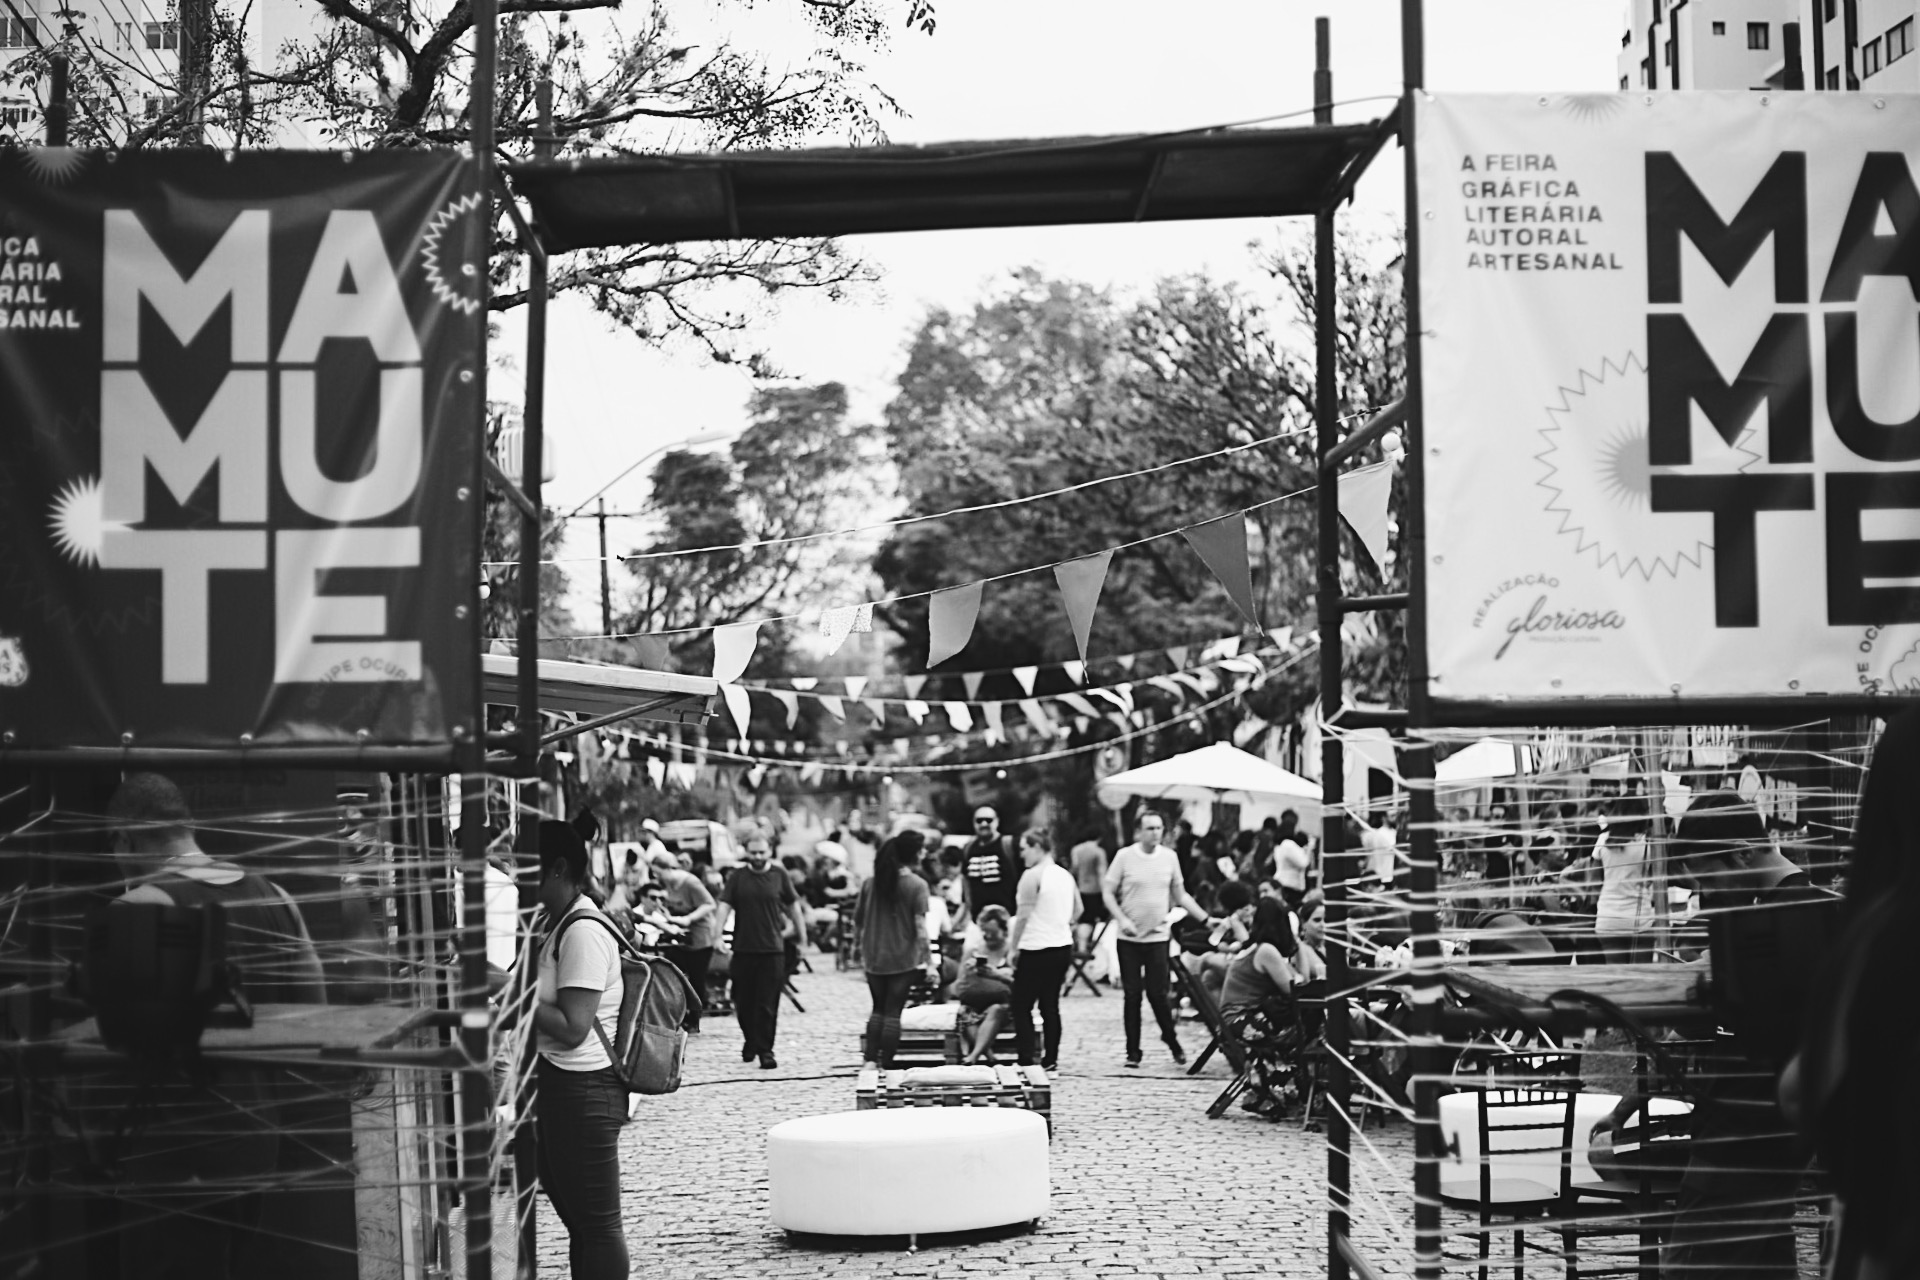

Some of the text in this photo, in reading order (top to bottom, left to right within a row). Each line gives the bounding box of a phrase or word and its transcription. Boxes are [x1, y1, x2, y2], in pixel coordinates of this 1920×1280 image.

[1461, 154, 1557, 171] A FEIRA
[1461, 176, 1580, 198] GRÁFICA
[1465, 201, 1603, 223] LITERÁRIA
[1466, 228, 1588, 246] AUTORAL
[1467, 252, 1623, 270] ARTESANAL
[103, 209, 422, 362] MA
[100, 367, 423, 521] MU
[98, 527, 421, 685] TE
[1472, 573, 1560, 628] REALIZAÇÃO
[1494, 594, 1625, 661] gloriosa
